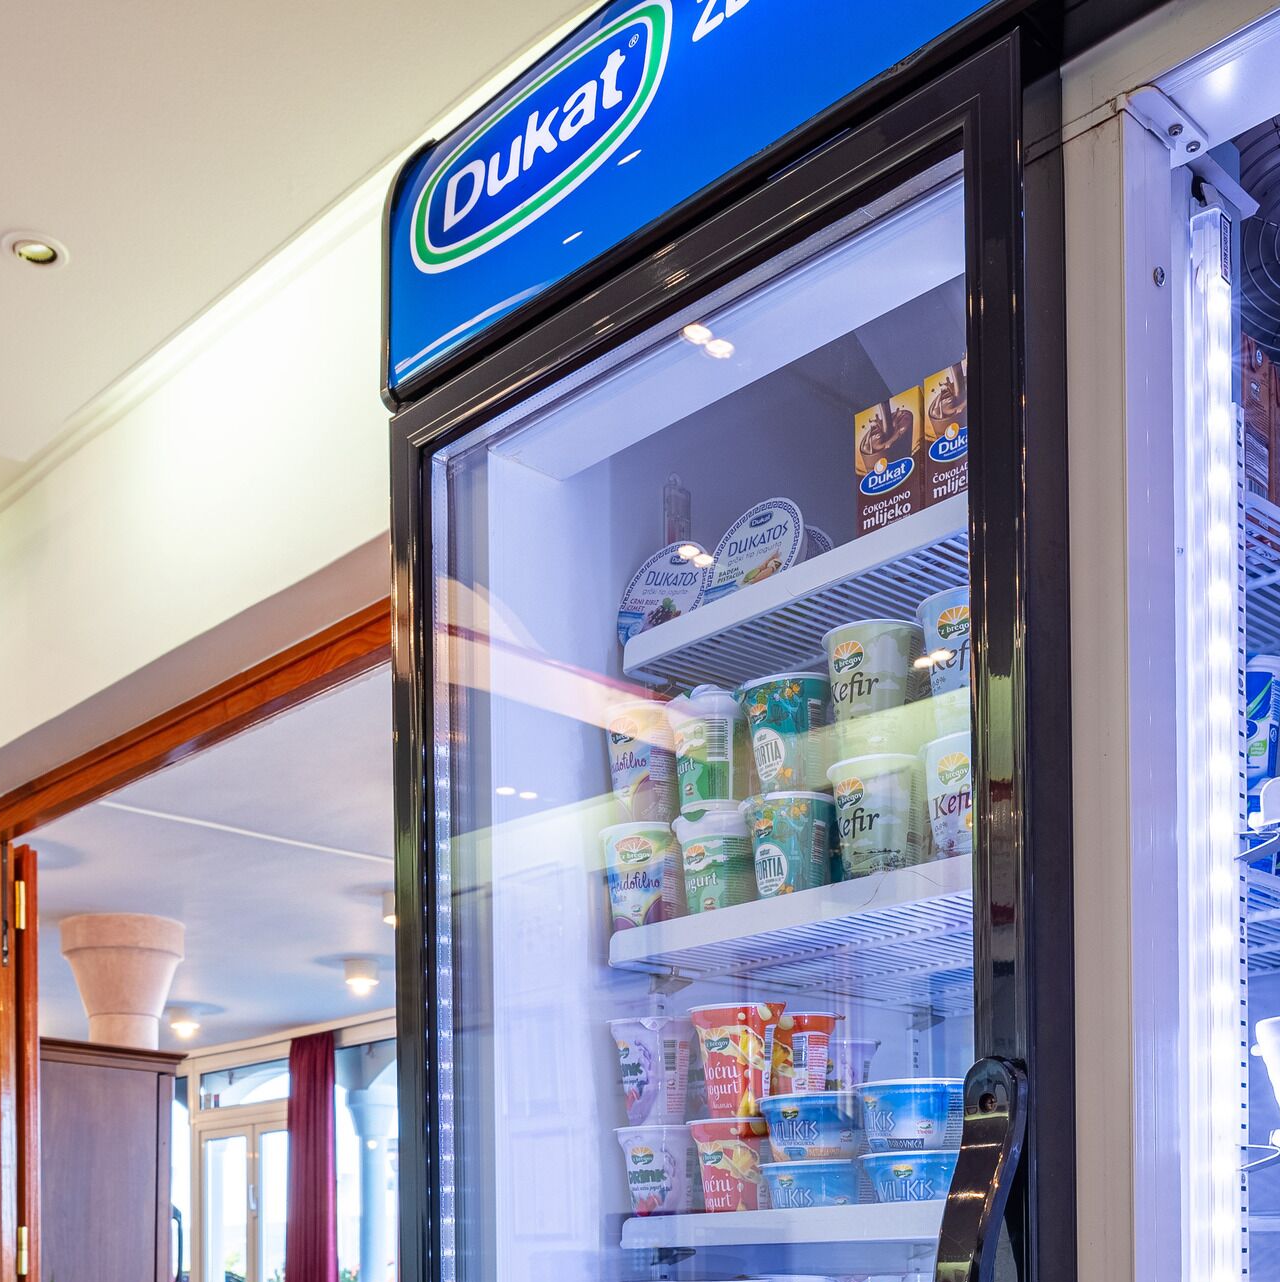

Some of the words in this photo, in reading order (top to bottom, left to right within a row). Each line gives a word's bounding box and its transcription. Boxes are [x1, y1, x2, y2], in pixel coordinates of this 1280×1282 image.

[442, 48, 626, 233] Dukat
[868, 462, 906, 488] Dukat
[862, 490, 911, 516] ČOKOLADNO
[863, 503, 912, 530] mlijeko
[727, 520, 789, 558] DUKATOS
[645, 570, 699, 587] DUKATOS
[838, 654, 862, 669] bregov
